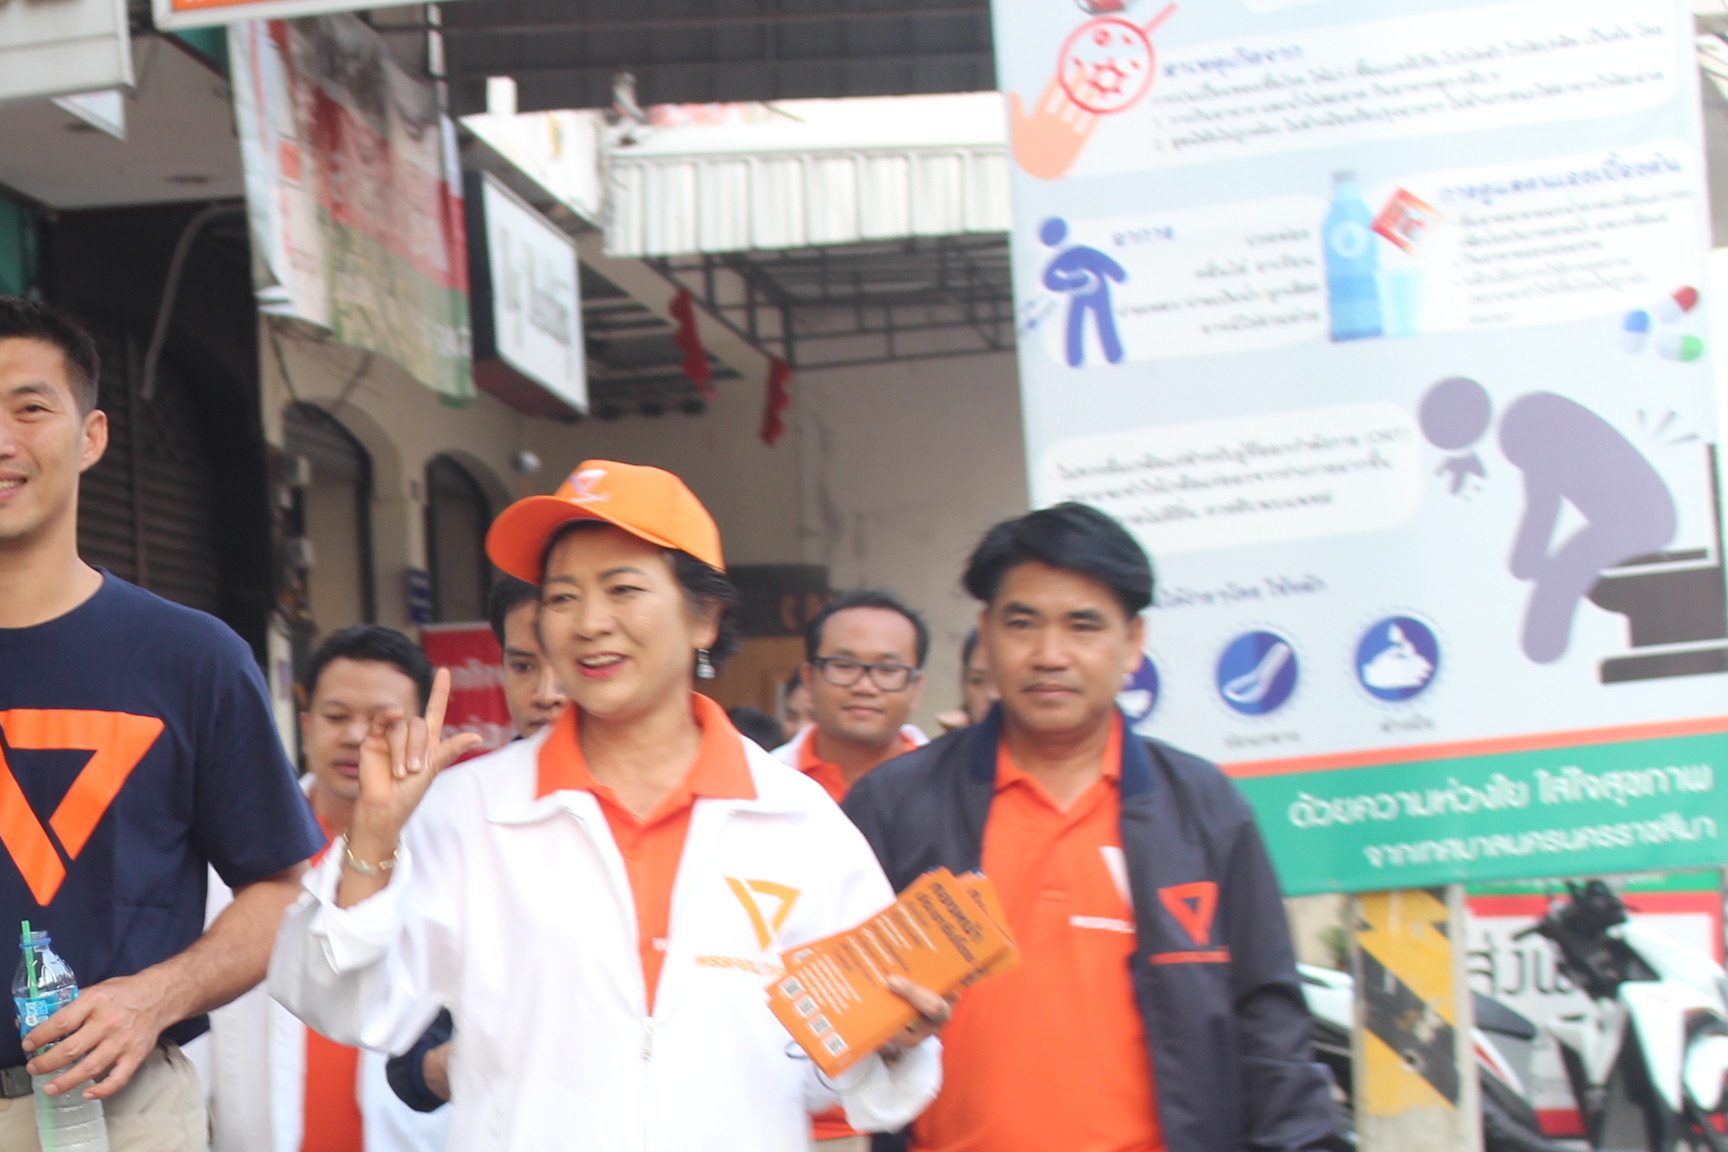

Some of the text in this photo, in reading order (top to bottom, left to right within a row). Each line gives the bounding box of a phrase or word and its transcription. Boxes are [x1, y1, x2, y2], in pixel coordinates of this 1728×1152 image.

[1287, 772, 1530, 828] ด้วยความห่วงใย
